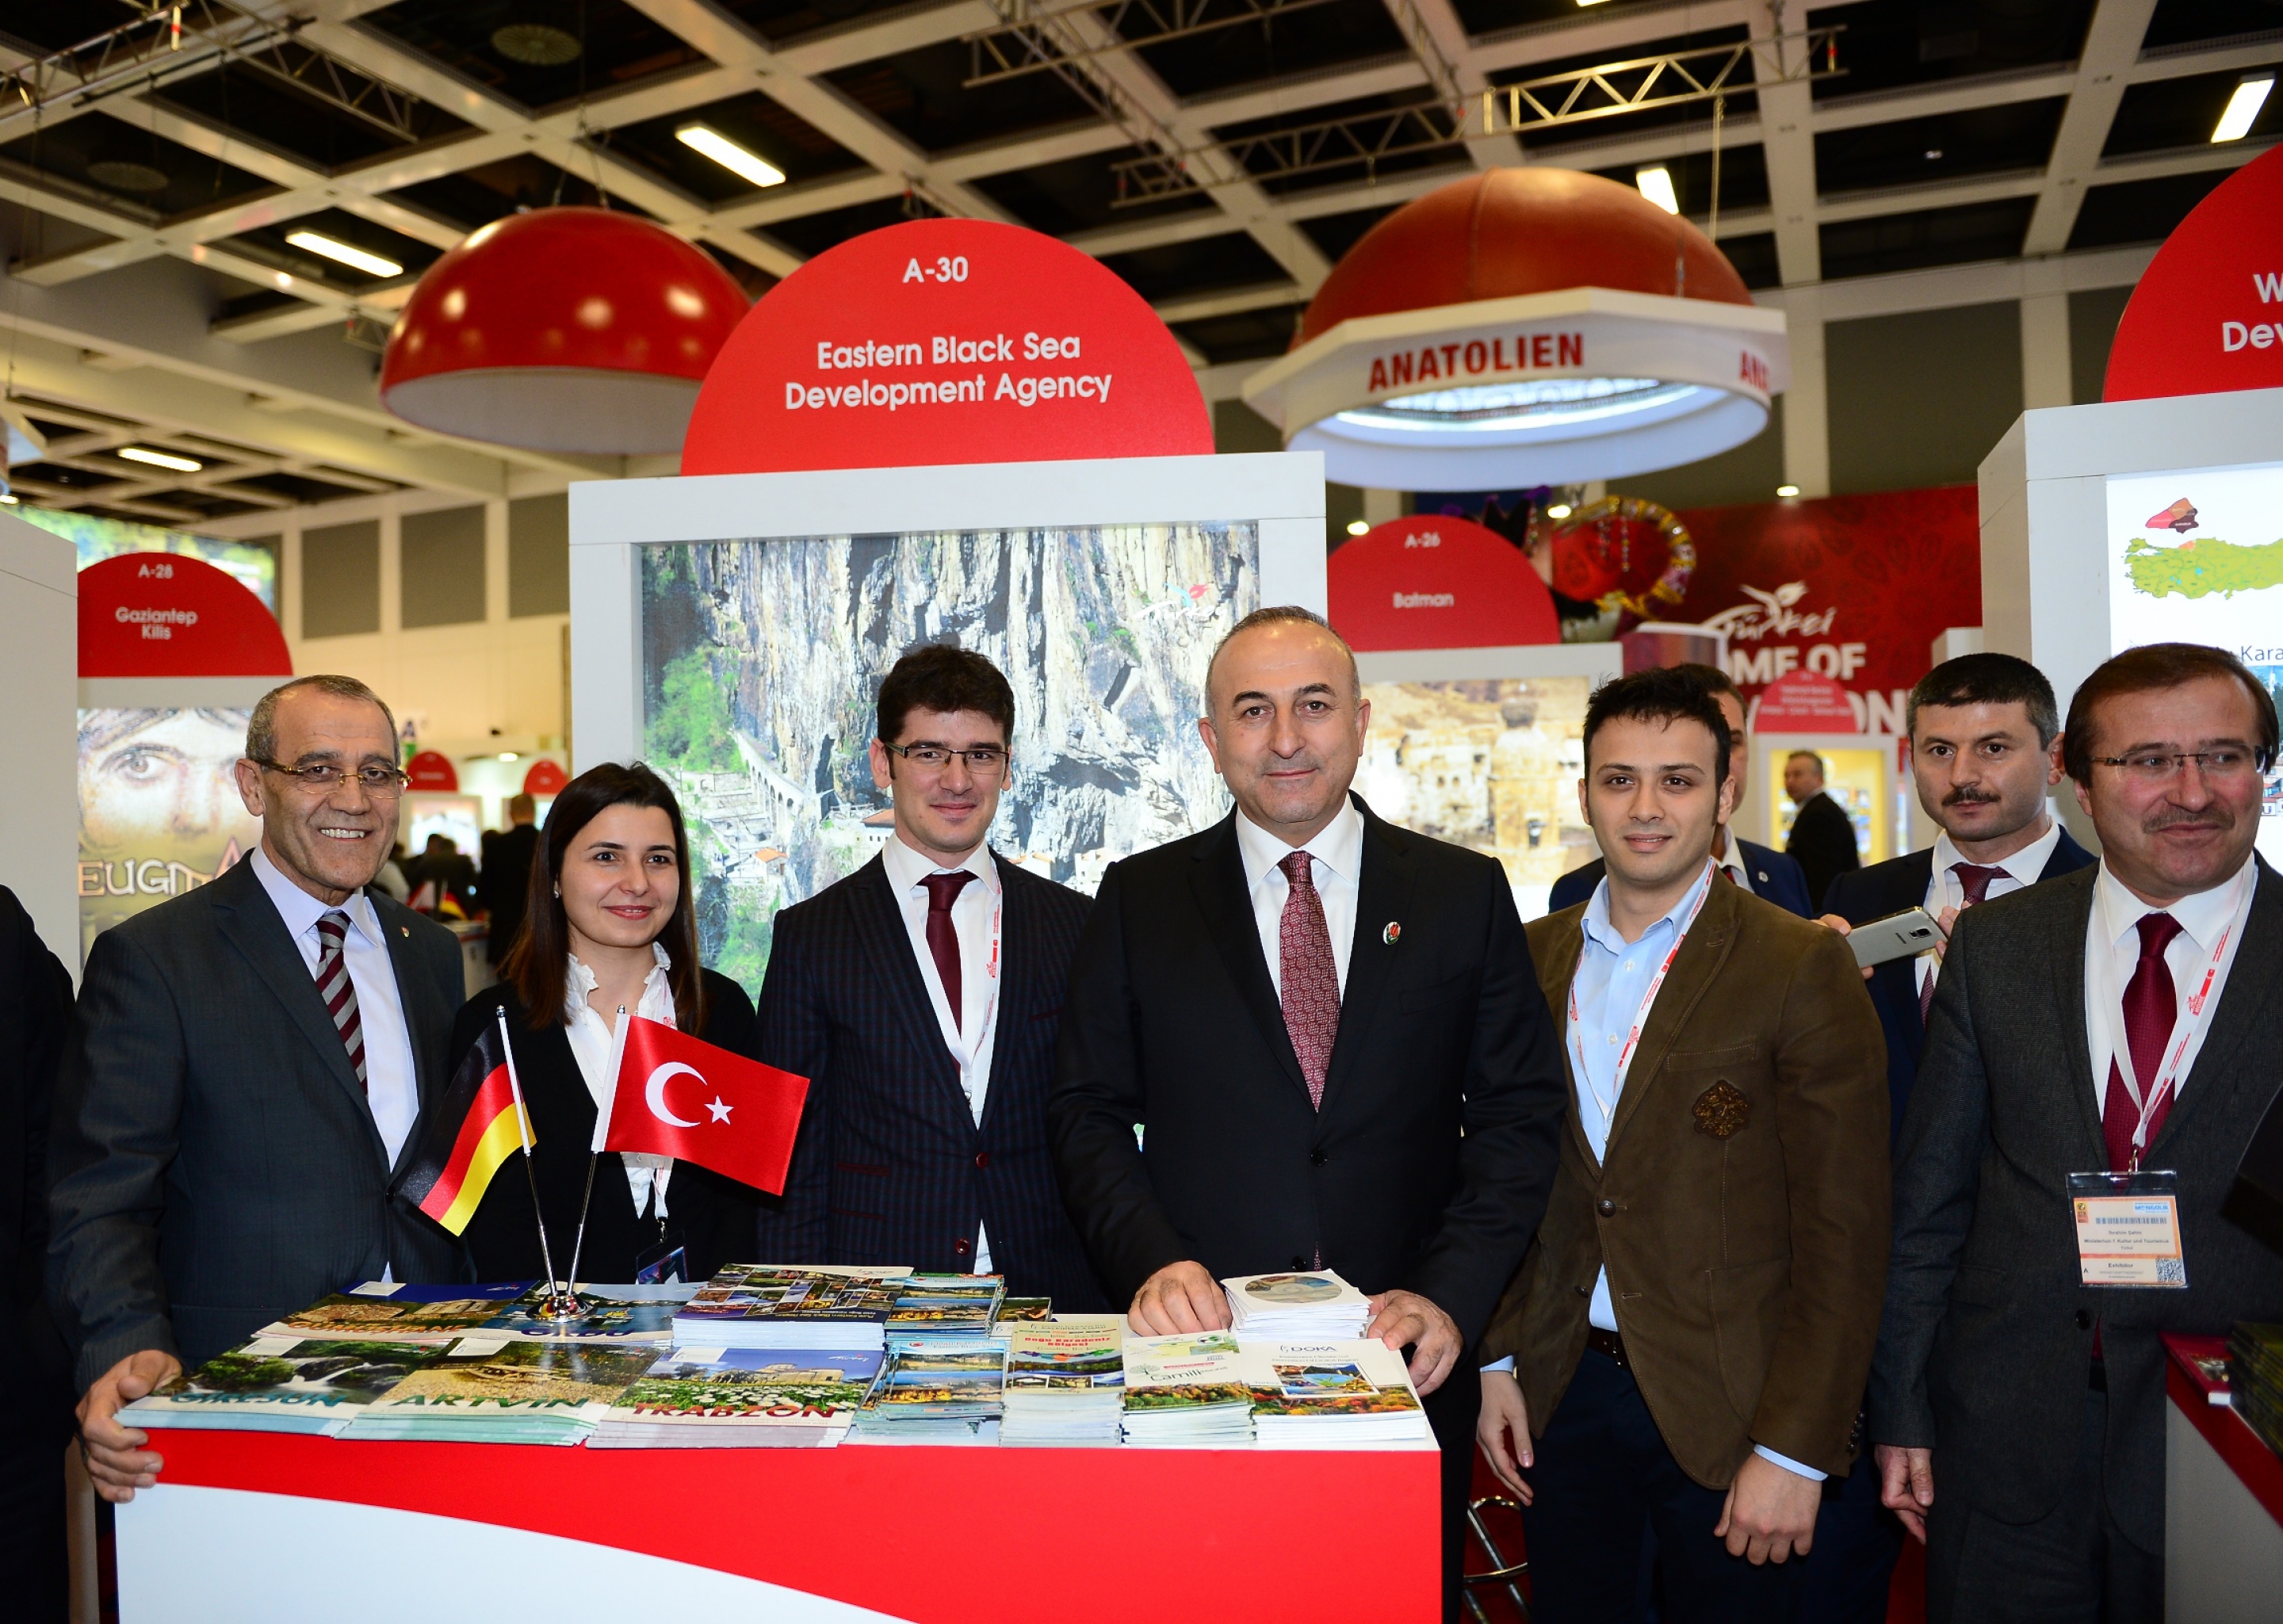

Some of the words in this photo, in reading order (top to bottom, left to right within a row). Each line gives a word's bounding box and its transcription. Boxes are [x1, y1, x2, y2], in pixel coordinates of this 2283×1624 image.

[903, 256, 969, 284] A-30
[817, 339, 923, 371] Eastern
[932, 334, 1015, 365] Black
[1023, 332, 1081, 361] Sea
[1368, 332, 1585, 393] ANATOLIEN
[785, 375, 986, 411] Development
[993, 373, 1113, 407] Agency
[1405, 531, 1441, 548] A-26
[137, 564, 174, 579] A-28
[1393, 592, 1455, 609] Batman
[115, 607, 198, 627] Gaziantep
[141, 624, 172, 640] Kilis
[1806, 642, 1867, 681] OF
[633, 1402, 838, 1418] TRABZON
